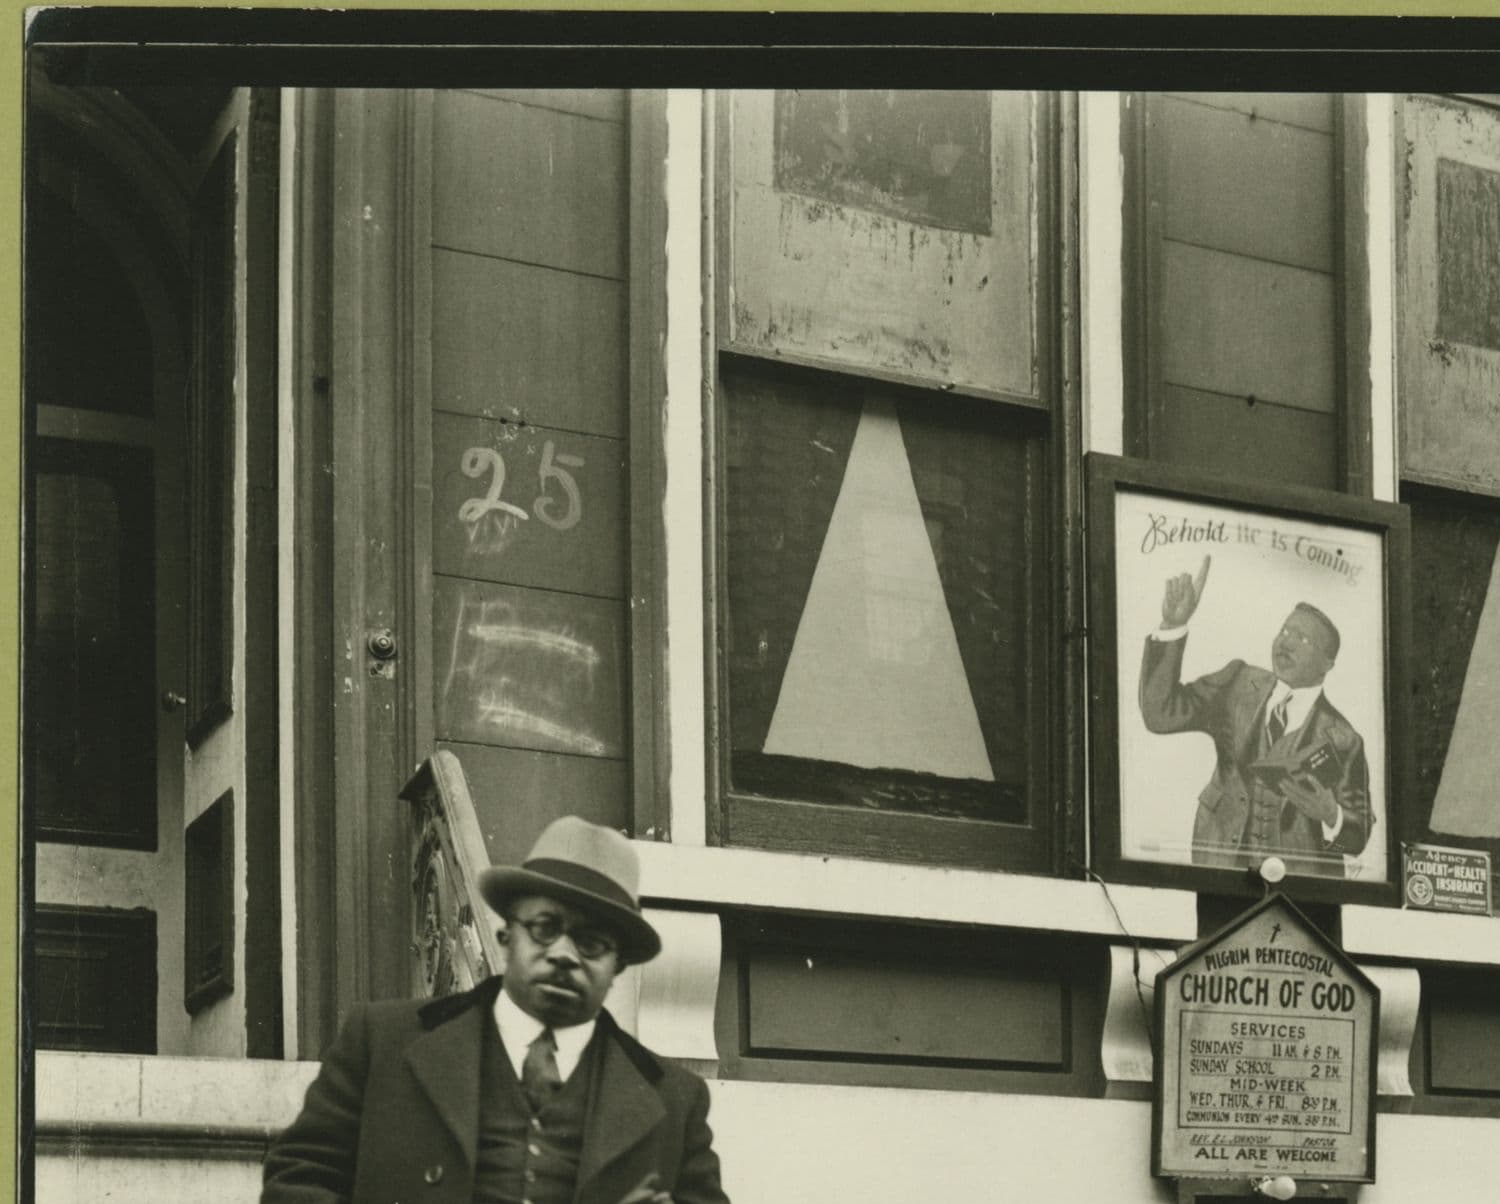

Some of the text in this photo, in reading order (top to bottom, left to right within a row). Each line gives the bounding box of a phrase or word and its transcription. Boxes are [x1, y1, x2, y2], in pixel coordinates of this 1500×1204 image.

[459, 440, 585, 530] 25
[1141, 512, 1229, 553] Behold
[1295, 535, 1364, 586] Coming
[1425, 850, 1467, 864] Agency
[1436, 877, 1484, 895] INSURANCE
[1204, 948, 1334, 977] PILGRIM PENTECOSTAL
[1180, 973, 1356, 1012] CHURCH OF GOD
[1231, 1022, 1306, 1039] SERVICES
[1190, 1040, 1243, 1055] SUNDAYS
[1190, 1059, 1229, 1074] SUNDAY
[1235, 1060, 1275, 1076] SCHOOL
[1310, 1064, 1320, 1078] 2
[1230, 1078, 1305, 1092] MID-WEEK
[1186, 1111, 1230, 1123] COMMUNION
[1234, 1112, 1260, 1124] EVERY
[1194, 1147, 1337, 1162] ALL ARE WELCOME
